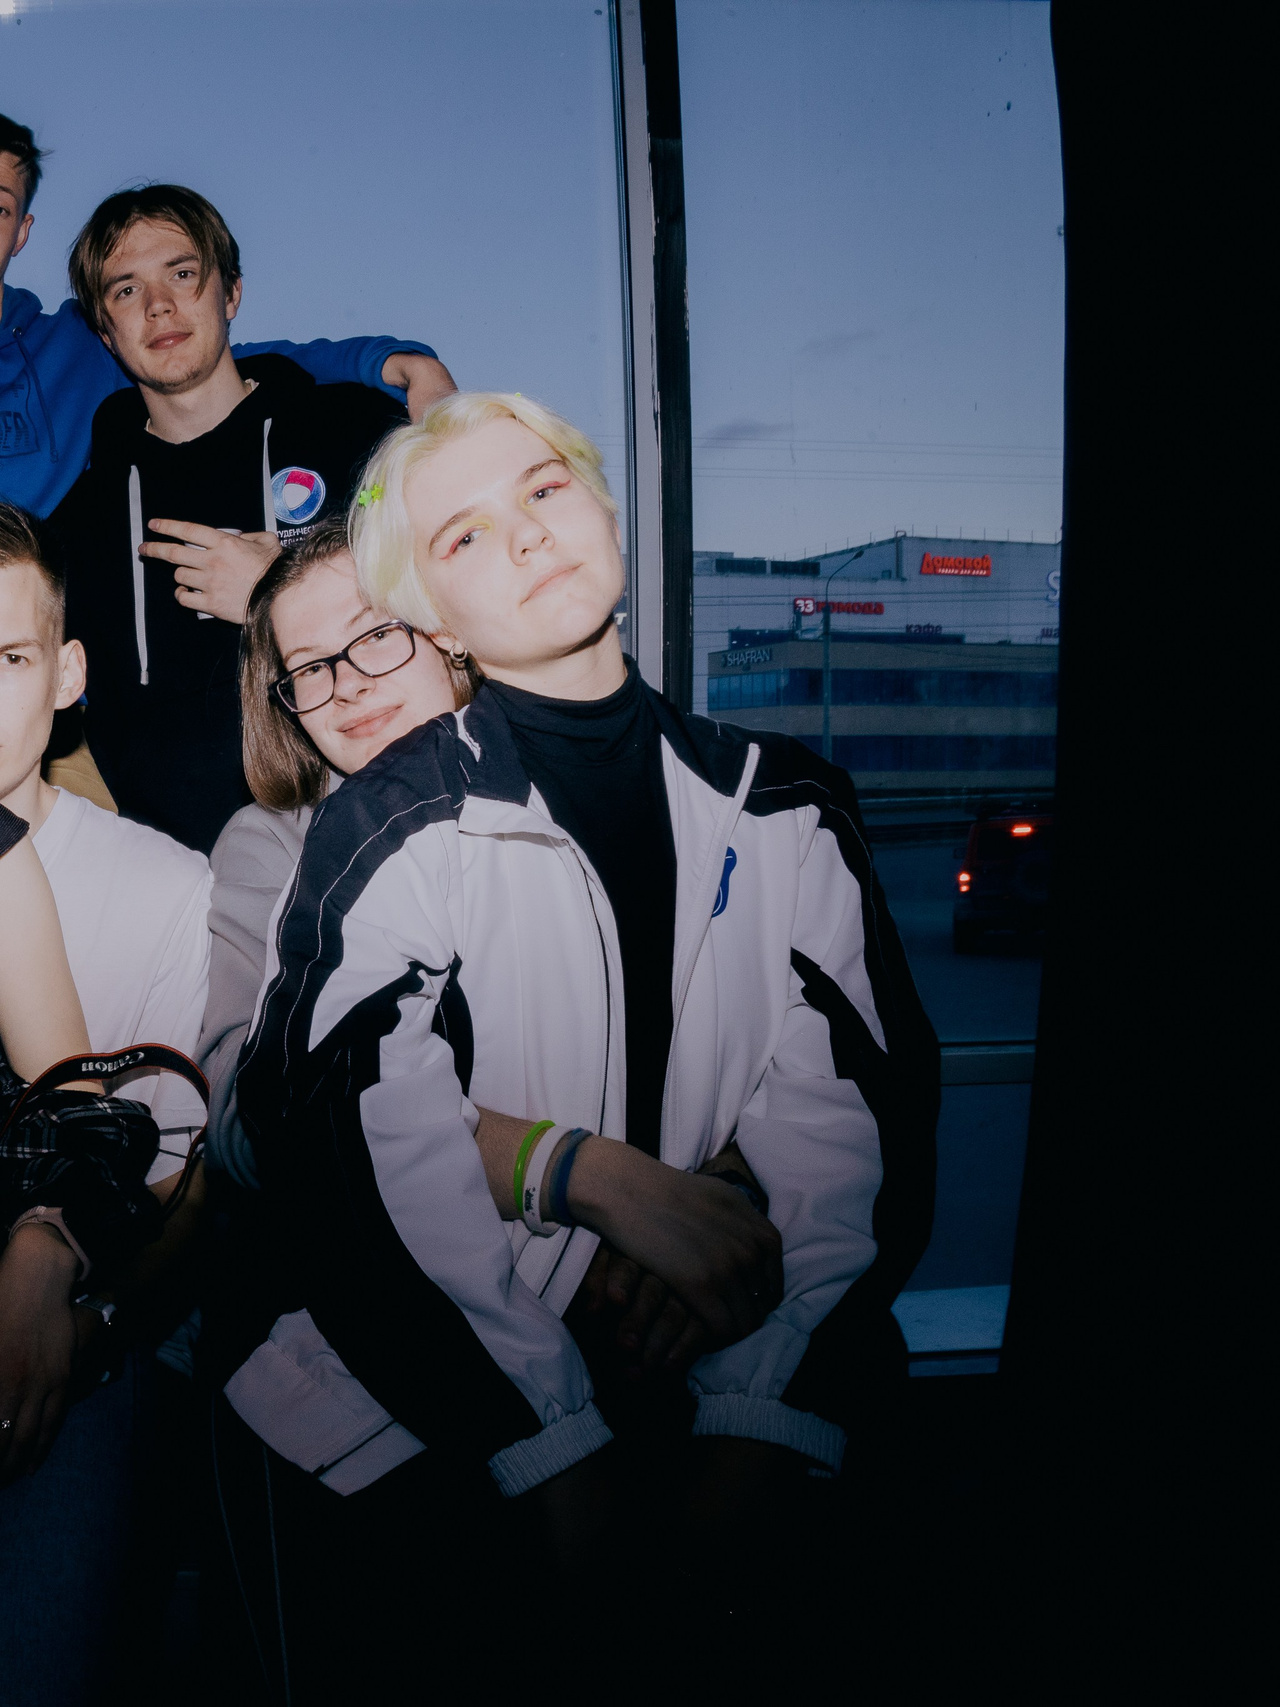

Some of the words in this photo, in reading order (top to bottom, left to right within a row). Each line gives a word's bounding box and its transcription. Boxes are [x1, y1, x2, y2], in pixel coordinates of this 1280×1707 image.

[905, 622, 942, 635] кафе
[727, 647, 771, 667] SHAFRAN
[81, 1051, 145, 1073] Canon
